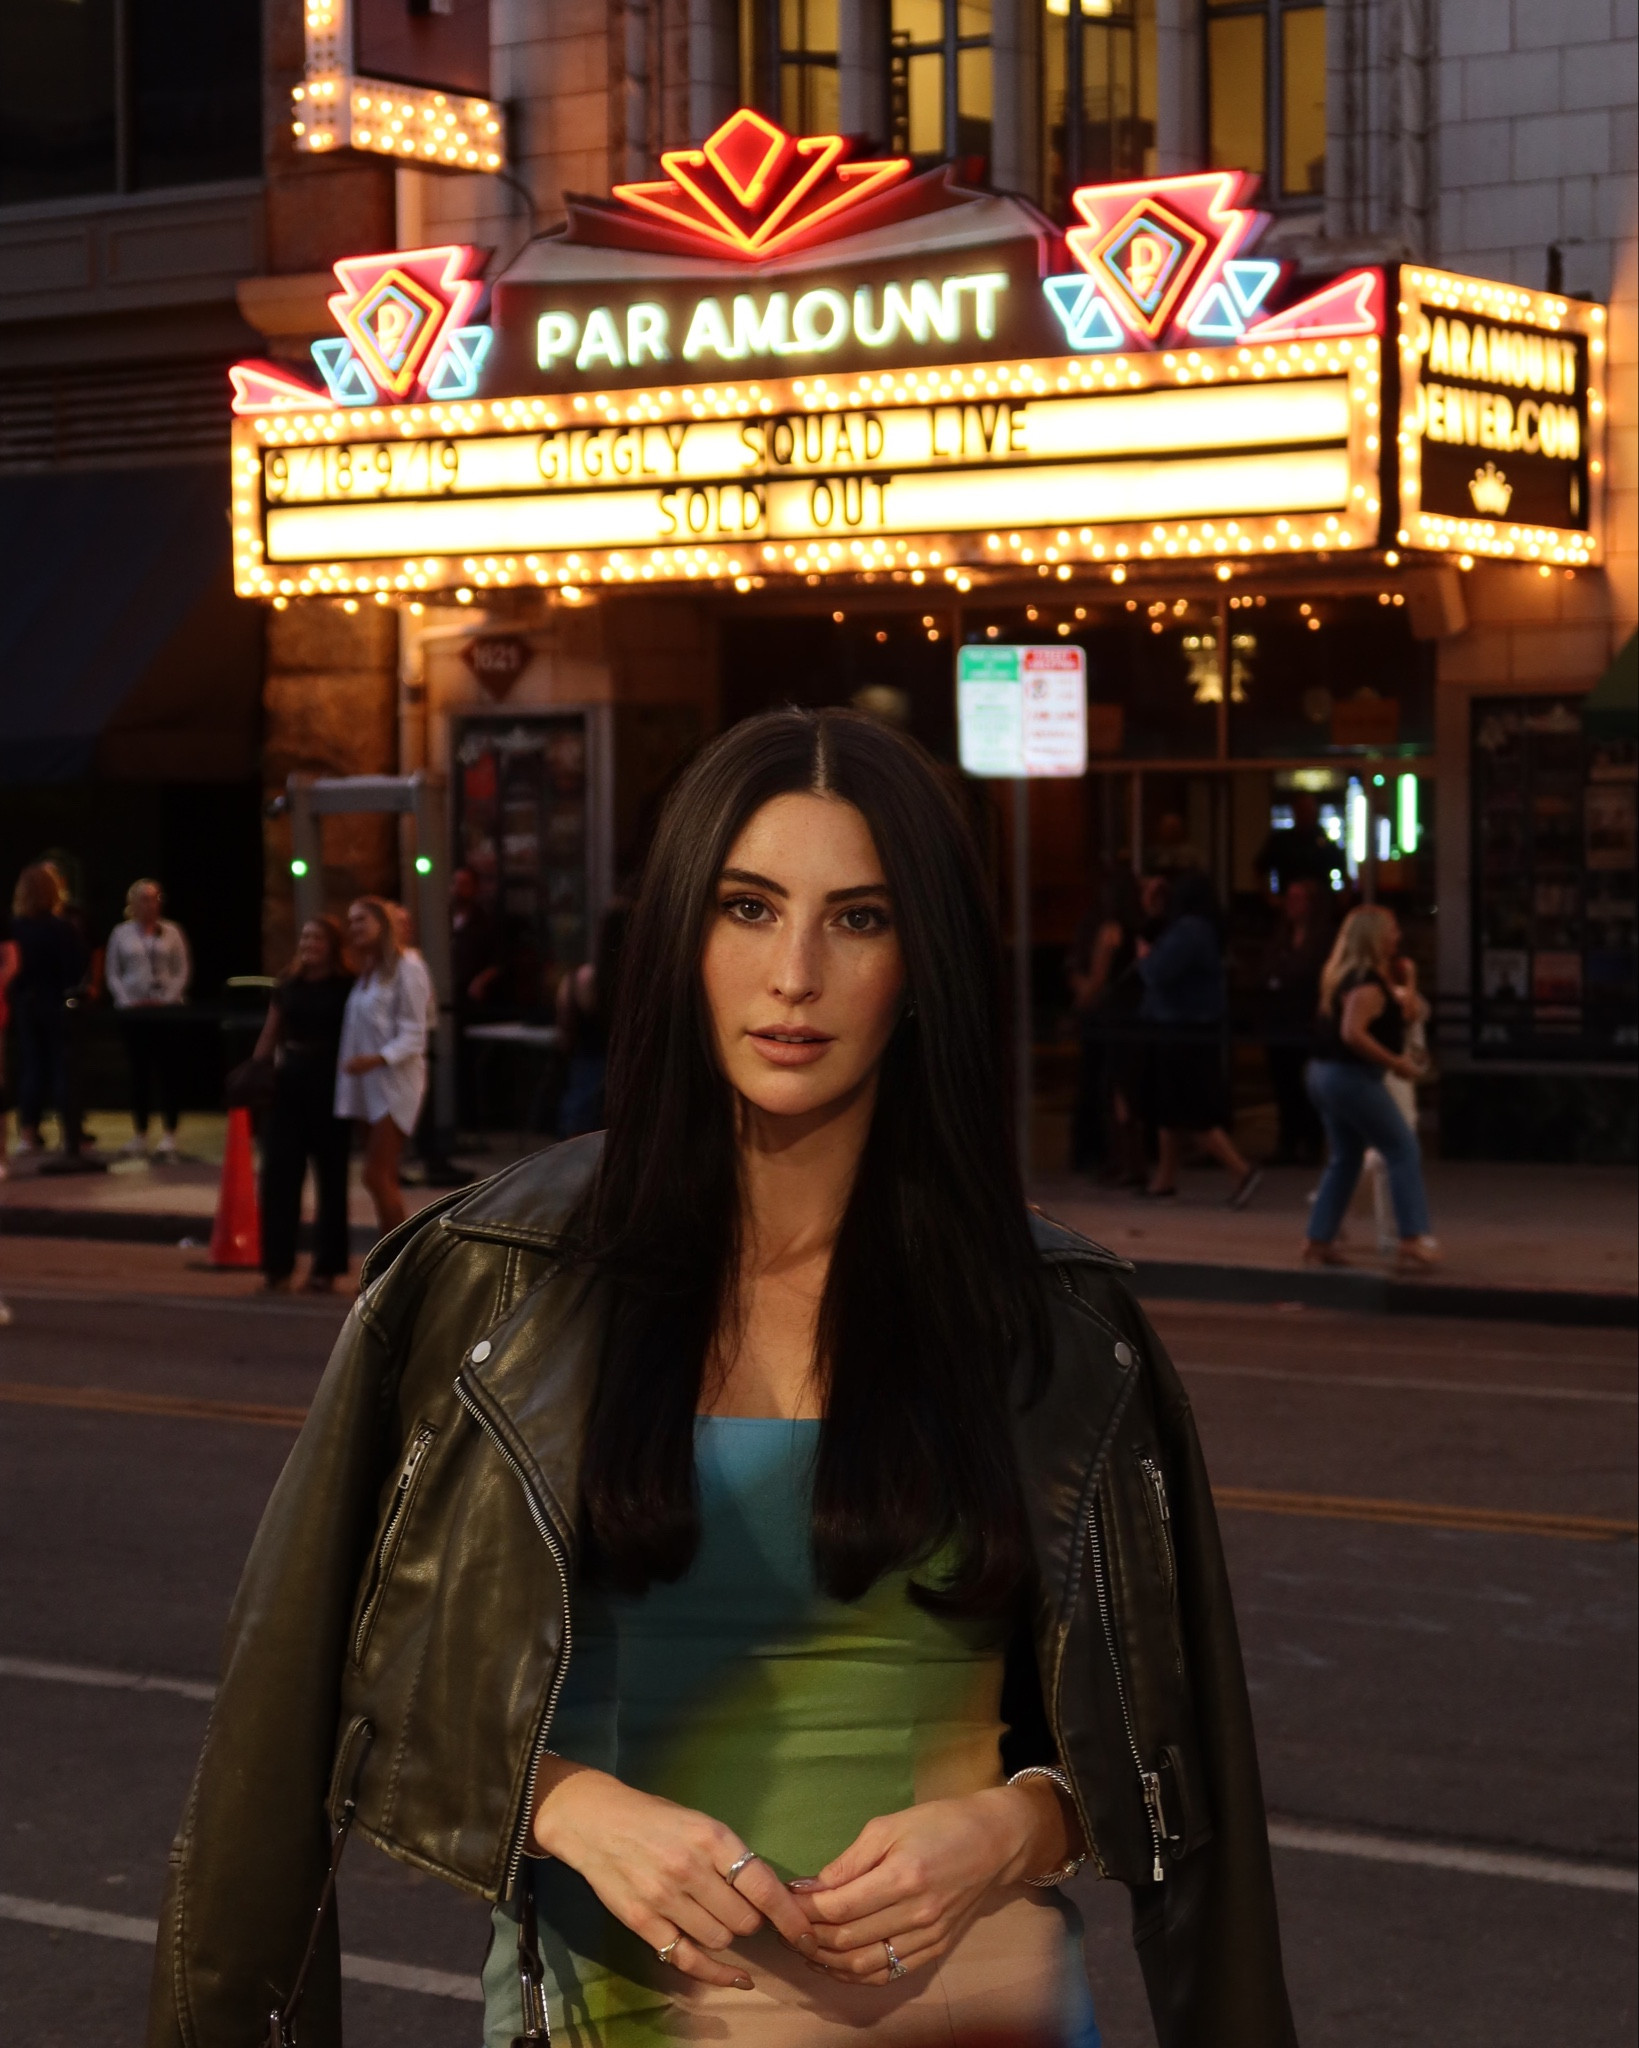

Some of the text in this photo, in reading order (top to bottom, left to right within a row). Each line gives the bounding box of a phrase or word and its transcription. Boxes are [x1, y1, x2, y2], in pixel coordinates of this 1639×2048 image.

[536, 273, 1008, 369] PARAMOUNT
[538, 423, 688, 481] GIGGLY
[740, 411, 886, 470] SQUAD
[931, 402, 1029, 459] LIVE
[659, 476, 892, 538] SOLD OUT
